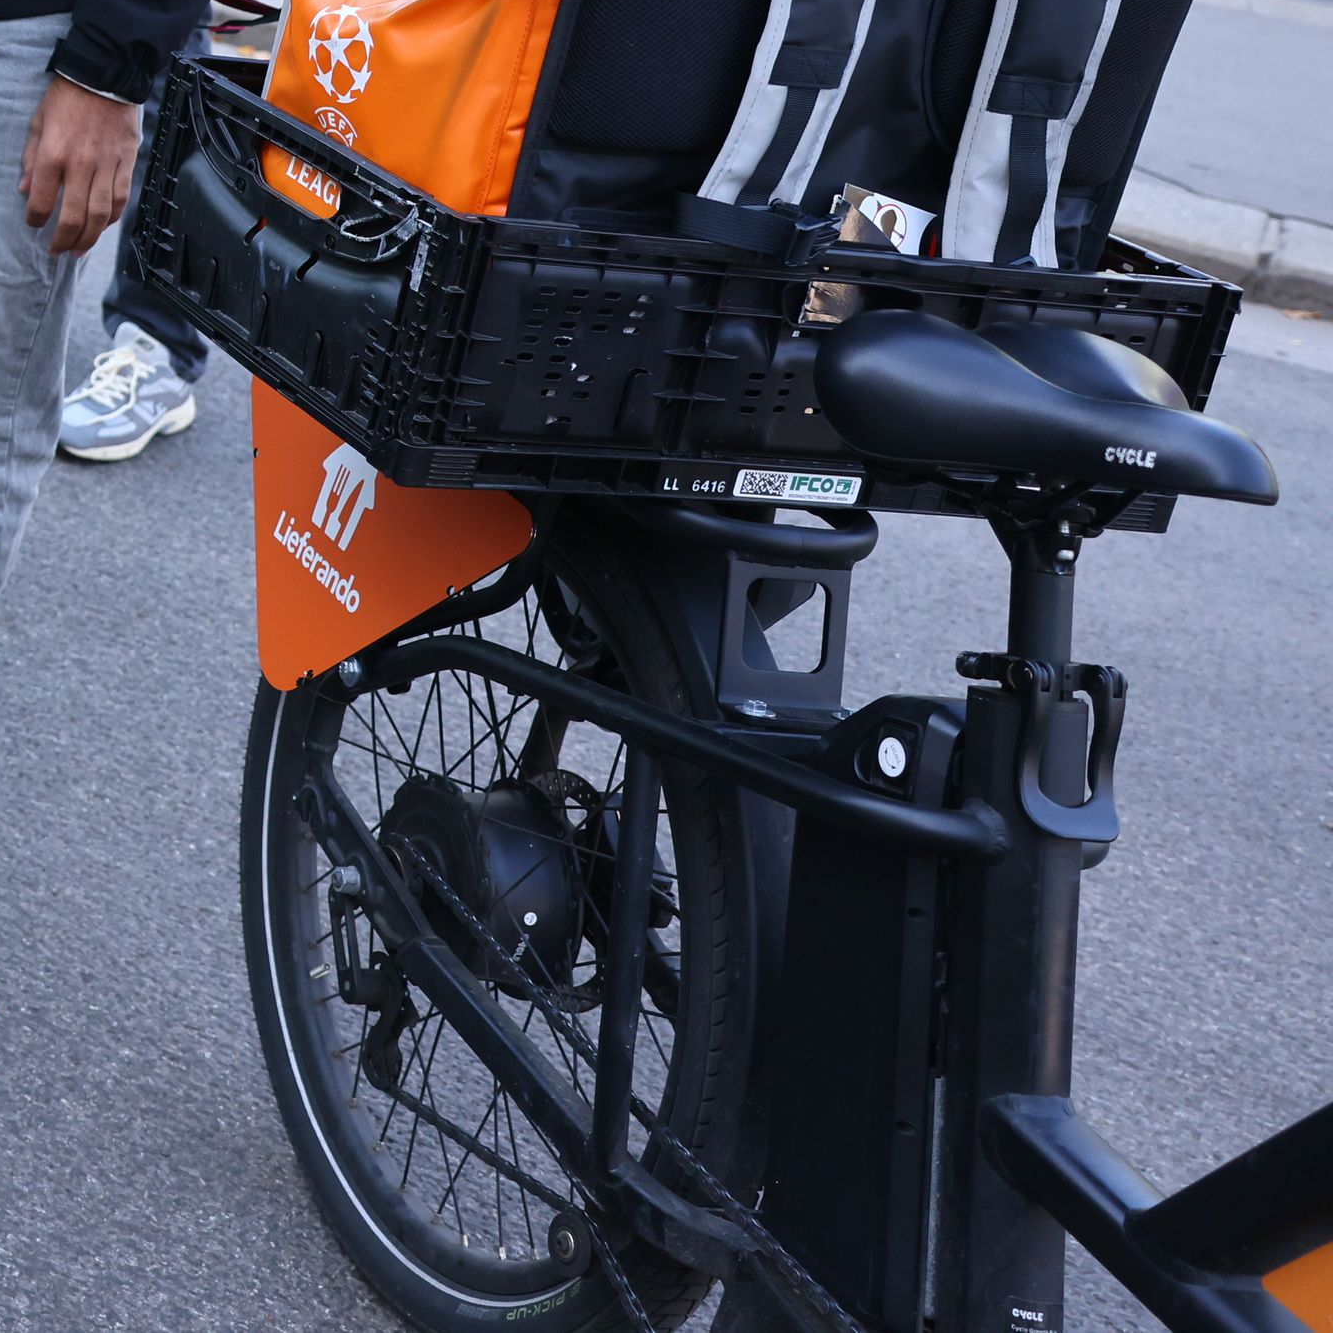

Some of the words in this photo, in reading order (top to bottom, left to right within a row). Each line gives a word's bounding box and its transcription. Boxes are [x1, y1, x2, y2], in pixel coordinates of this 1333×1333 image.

[317, 112, 354, 147] UEFA
[1104, 446, 1157, 469] CYCLE
[663, 477, 680, 491] LL
[691, 479, 726, 494] 6416
[789, 475, 835, 494] IFCO
[273, 510, 360, 613] Lieferando
[1011, 1308, 1044, 1322] CYCLE
